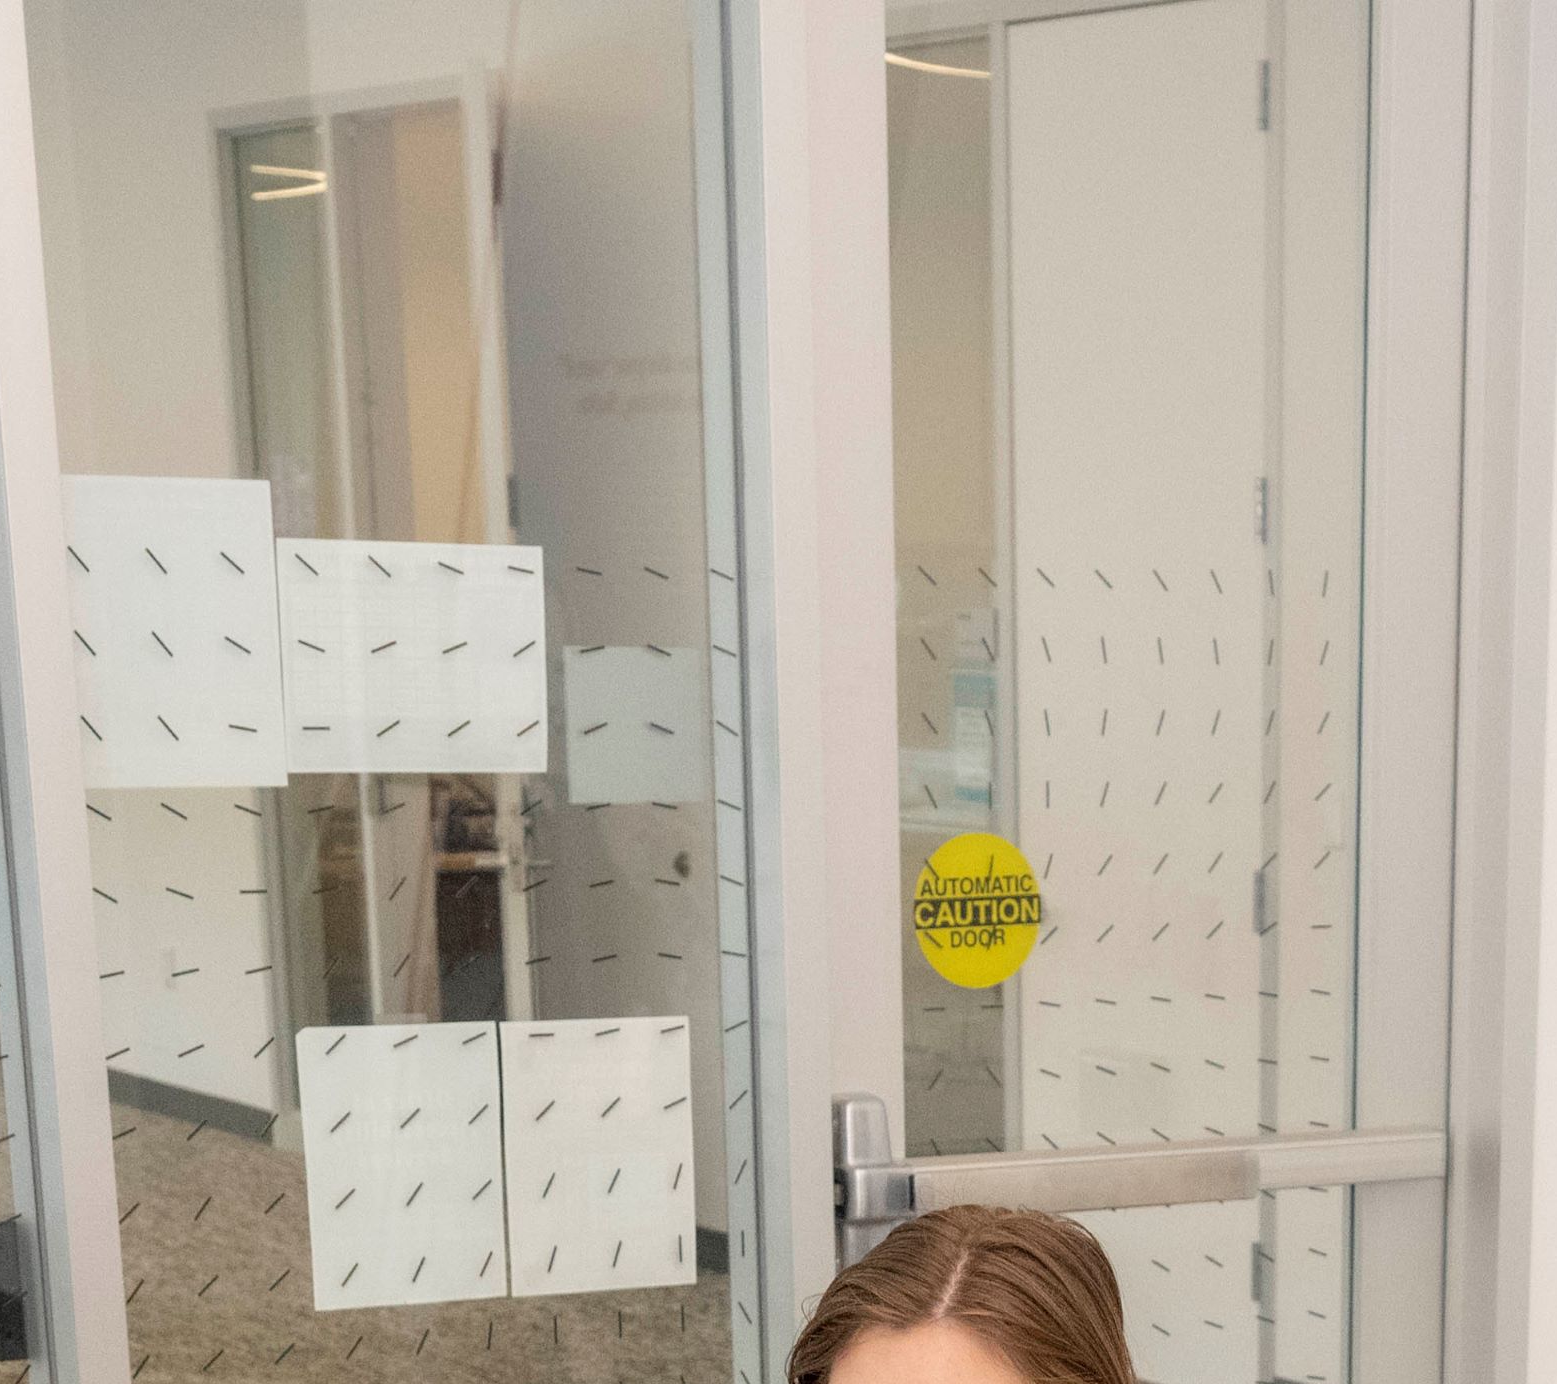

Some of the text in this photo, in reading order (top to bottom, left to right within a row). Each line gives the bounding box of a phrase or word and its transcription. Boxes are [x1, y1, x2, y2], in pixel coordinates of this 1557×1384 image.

[920, 874, 1033, 896] AUTOMATIC
[915, 898, 1039, 927] CAUTION
[950, 928, 1005, 948] DOOR
